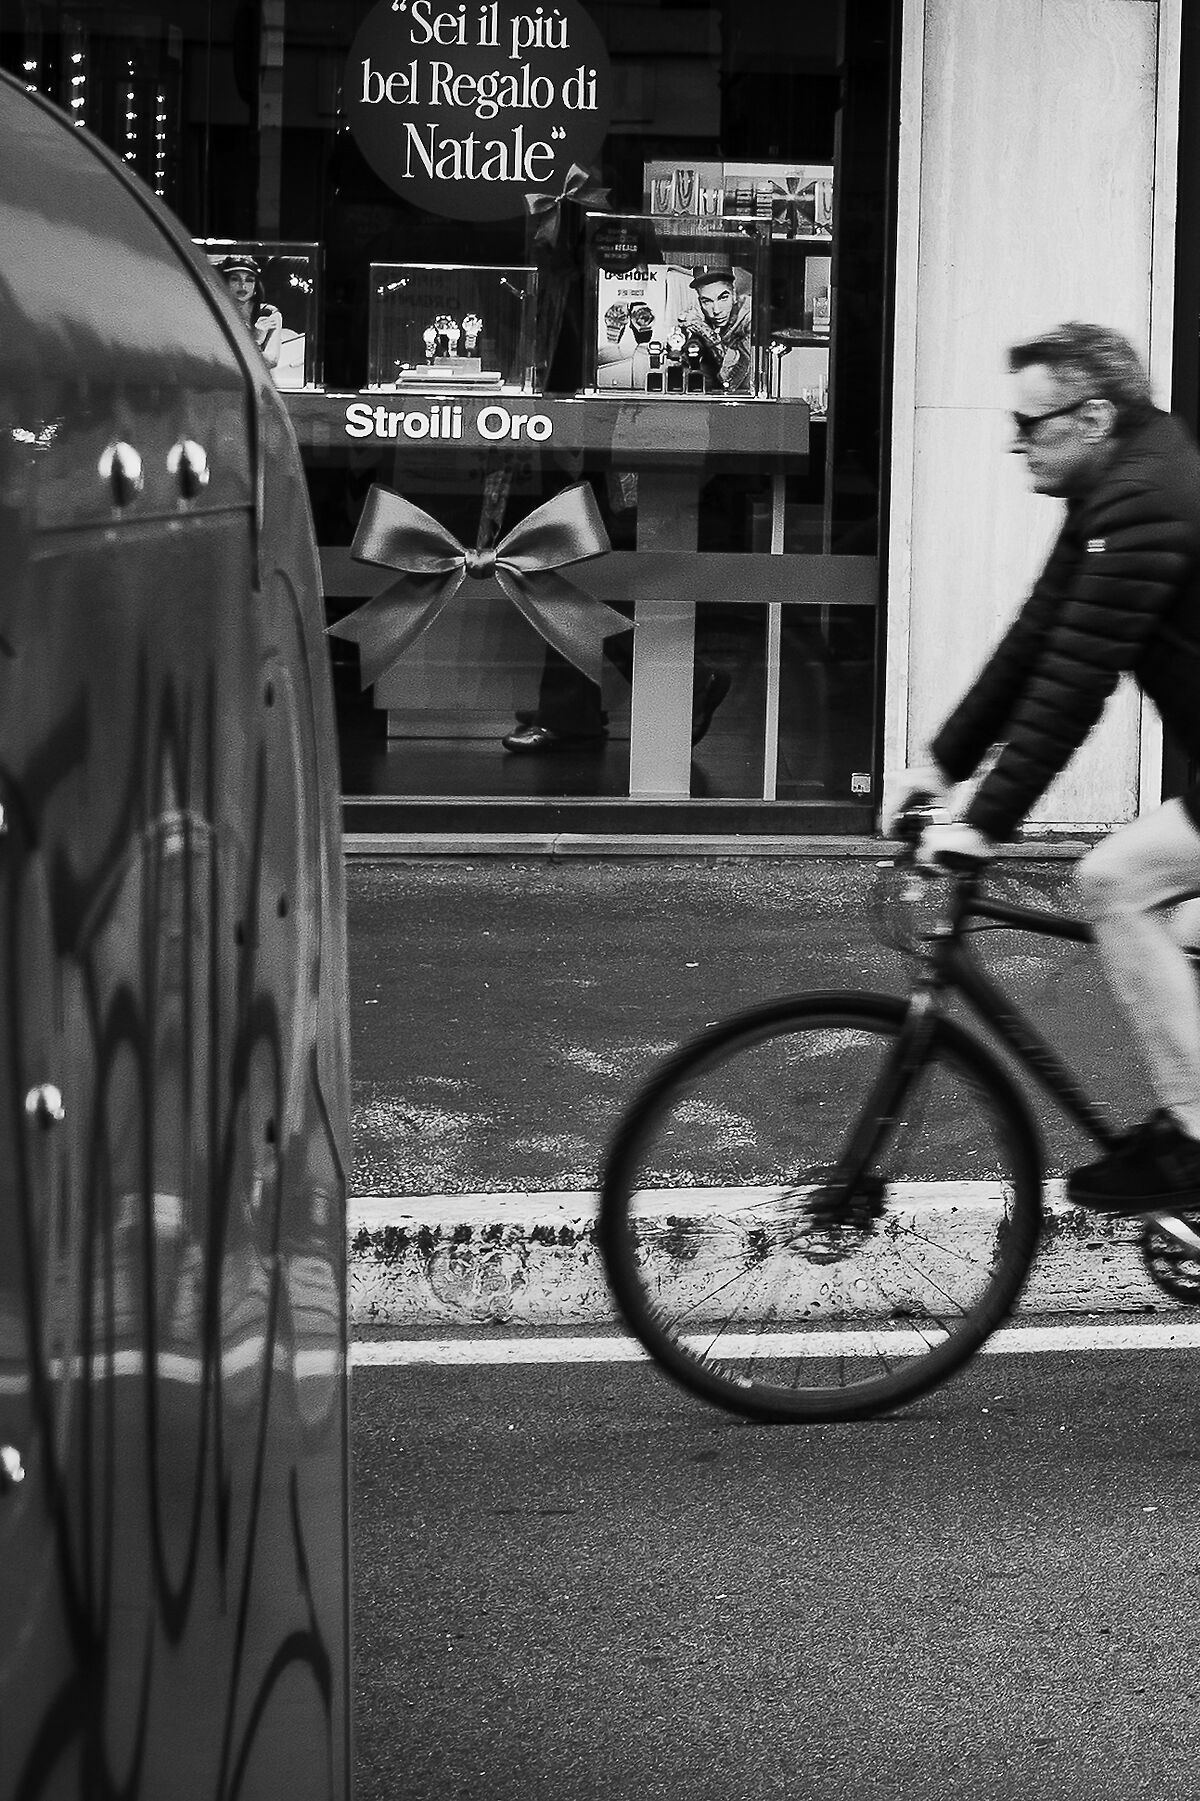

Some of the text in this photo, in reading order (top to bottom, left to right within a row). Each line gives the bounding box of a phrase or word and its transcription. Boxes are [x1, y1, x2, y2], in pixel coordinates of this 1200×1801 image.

[477, 1, 500, 46] il
[508, 7, 570, 60] più
[359, 57, 598, 120] bel Regalo di
[345, 403, 553, 441] Stroili Oro
